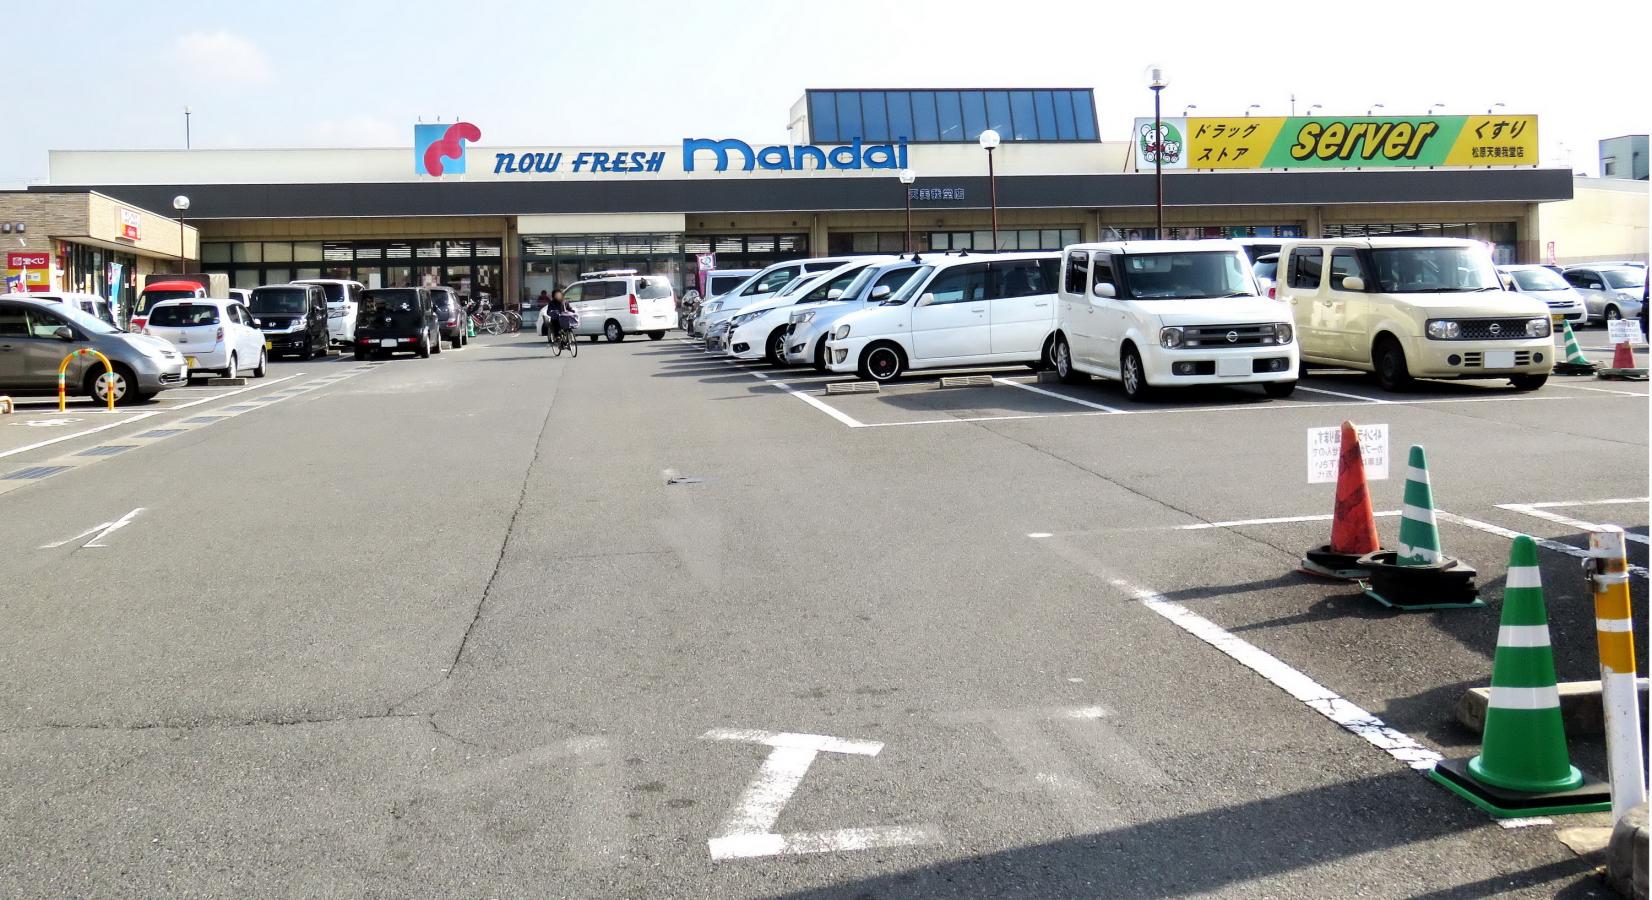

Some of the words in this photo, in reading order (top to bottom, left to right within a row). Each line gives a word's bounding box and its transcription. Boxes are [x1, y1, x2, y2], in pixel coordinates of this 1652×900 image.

[1195, 123, 1260, 139] ドラッグ
[1475, 120, 1527, 140] くすり
[1290, 121, 1440, 161] server
[1197, 146, 1249, 161] ストア
[1472, 146, 1525, 158] 松原天美我堂店
[572, 151, 666, 174] FRESH
